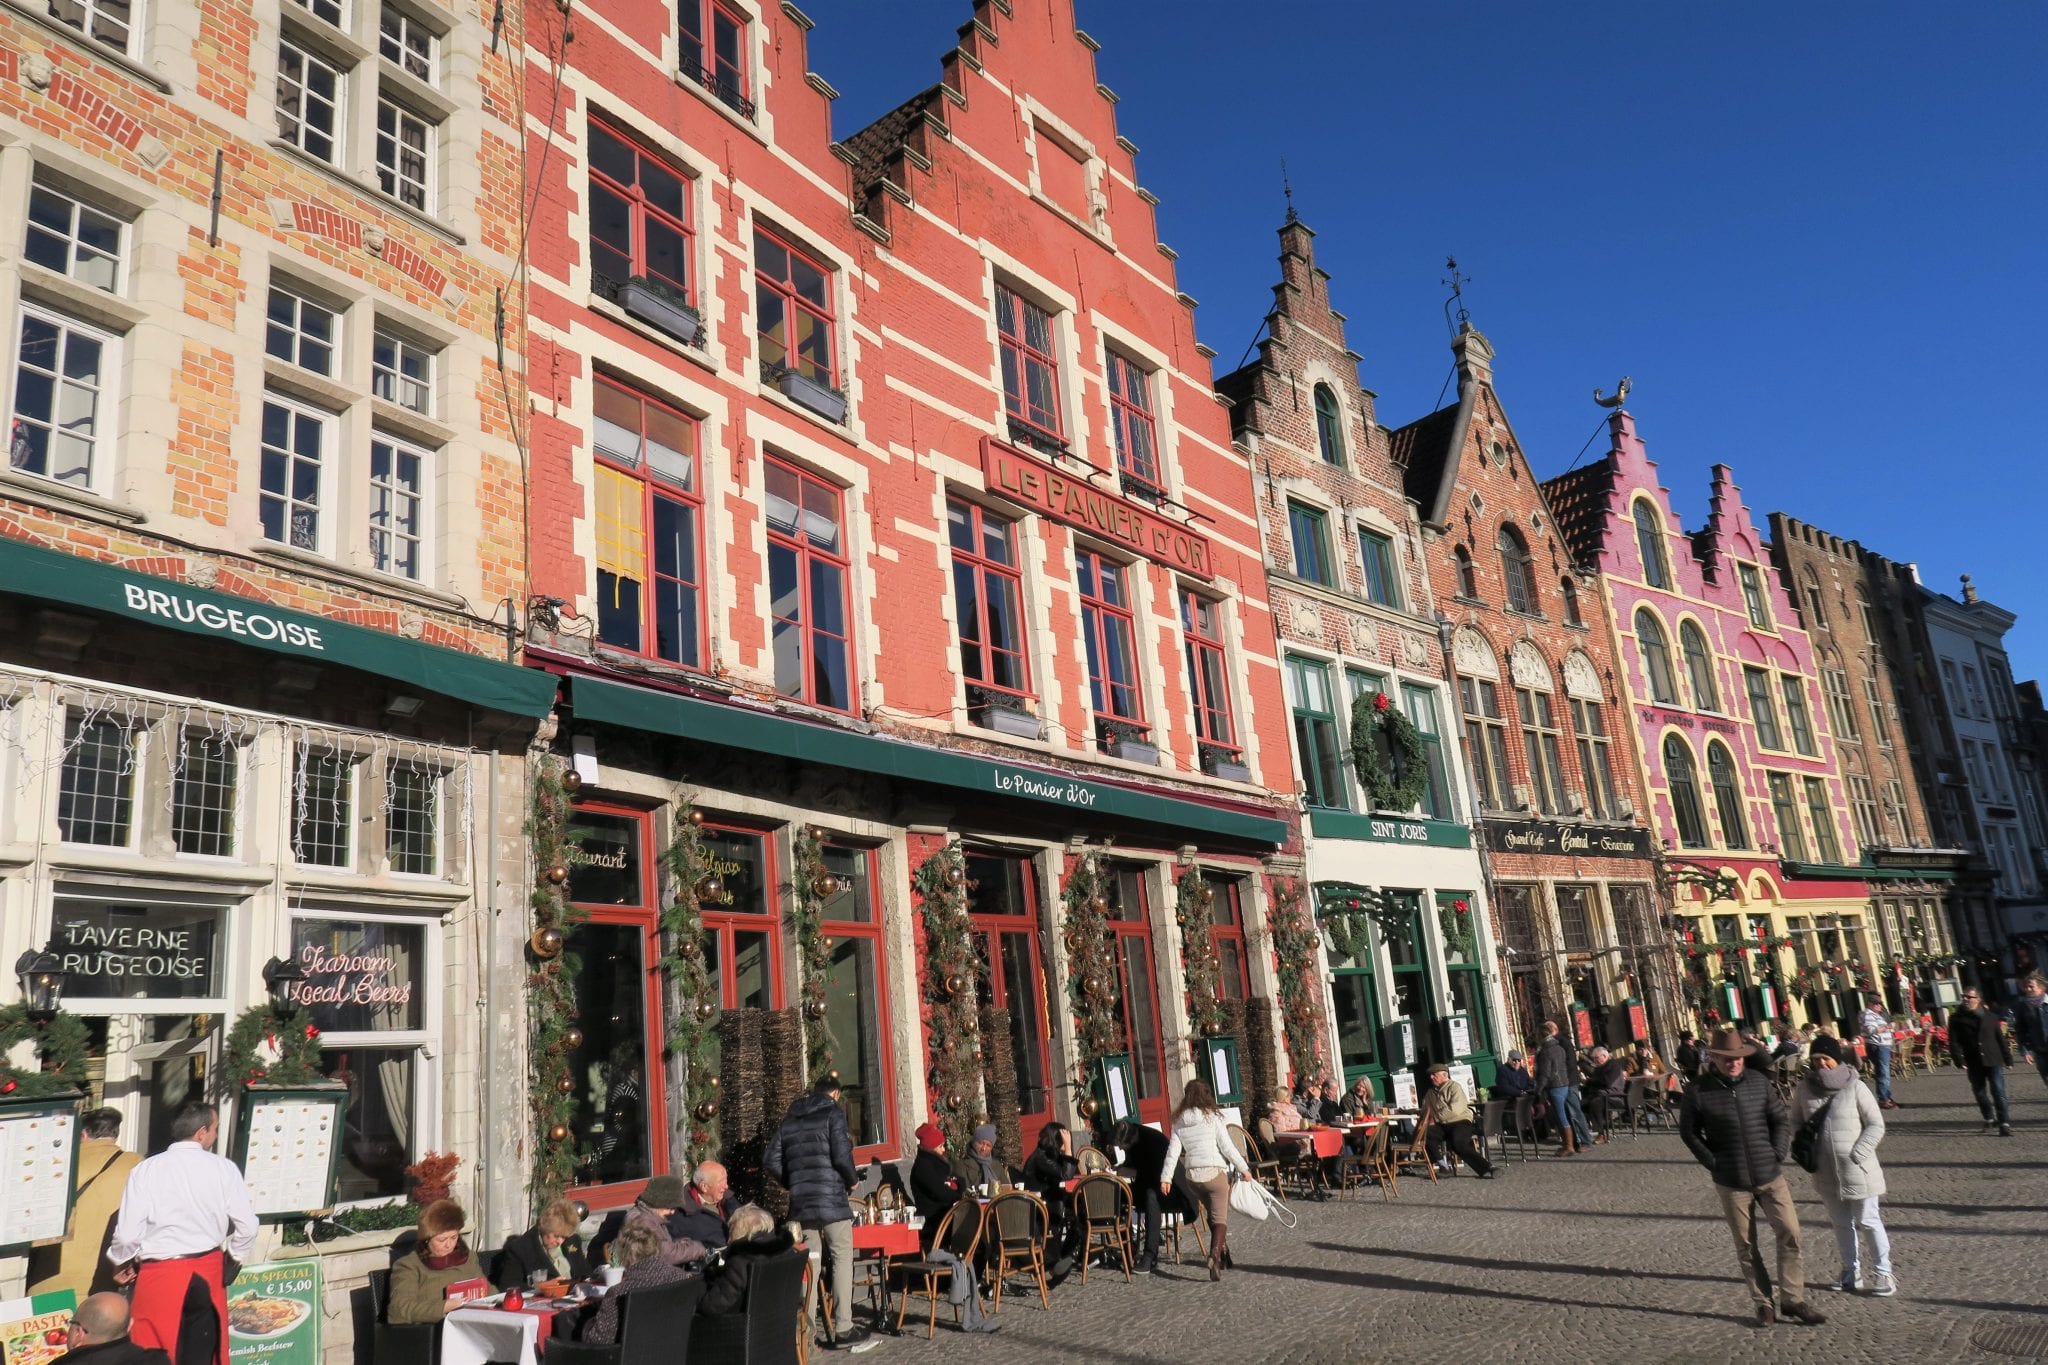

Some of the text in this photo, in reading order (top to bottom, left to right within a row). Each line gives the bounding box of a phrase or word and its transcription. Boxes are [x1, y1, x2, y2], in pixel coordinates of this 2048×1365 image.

[1000, 459, 1204, 571] LE PANIER D'OR
[124, 583, 324, 650] BRUGEOISE
[995, 769, 1095, 806] Le Panier d'Or
[1371, 821, 1428, 841] SINT JORIS
[1558, 826, 1589, 852] Central
[65, 924, 190, 950] TAVERNE
[50, 953, 205, 977] RUGEOISE
[301, 945, 397, 977] Tearoom
[290, 973, 410, 1005] Local Beers
[235, 1267, 312, 1286] AY'S SPECIAL
[278, 1279, 312, 1294] 15,00
[22, 1313, 68, 1333] PASTA
[229, 1341, 294, 1356] lemish Beefstew
